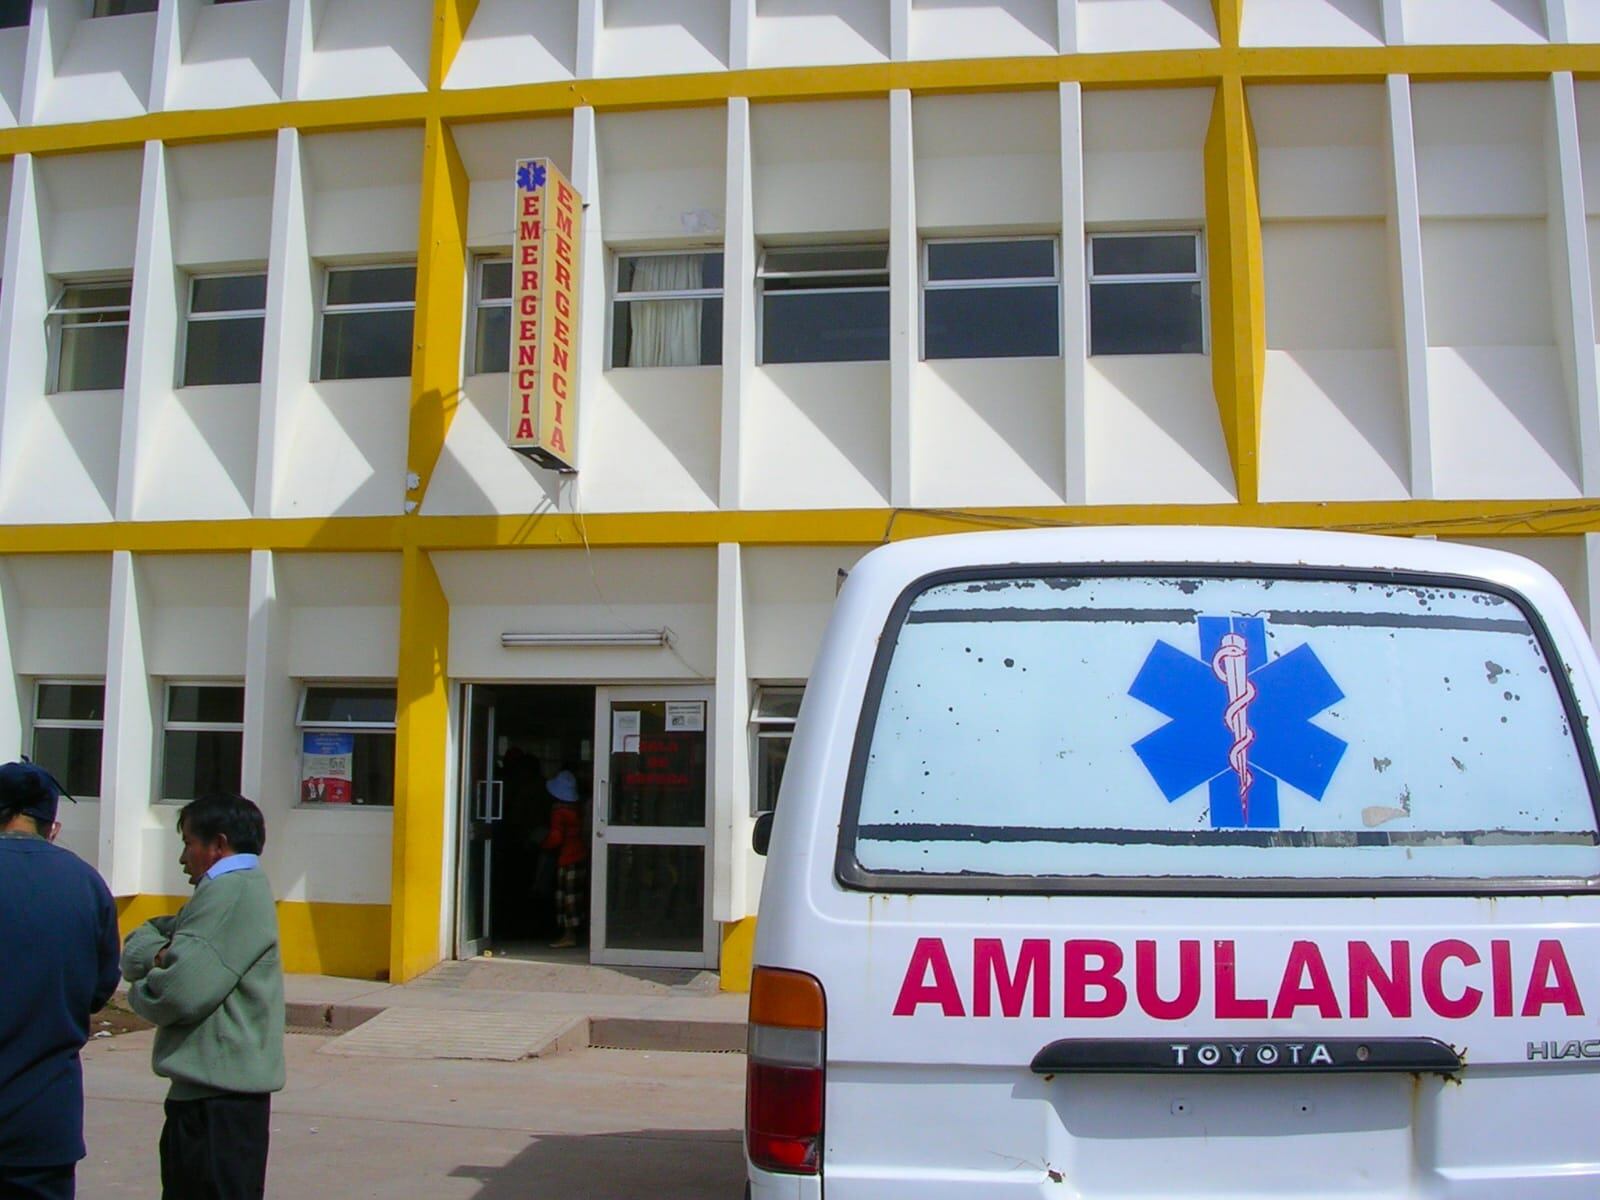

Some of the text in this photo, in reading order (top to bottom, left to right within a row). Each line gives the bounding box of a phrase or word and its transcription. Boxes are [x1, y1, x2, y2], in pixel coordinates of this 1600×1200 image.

[516, 196, 541, 438] EMERGENCIA
[550, 181, 573, 453] EMERGENCIA
[892, 937, 1586, 1020] AMBULANCIA
[1170, 1043, 1334, 1066] TOYOTA
